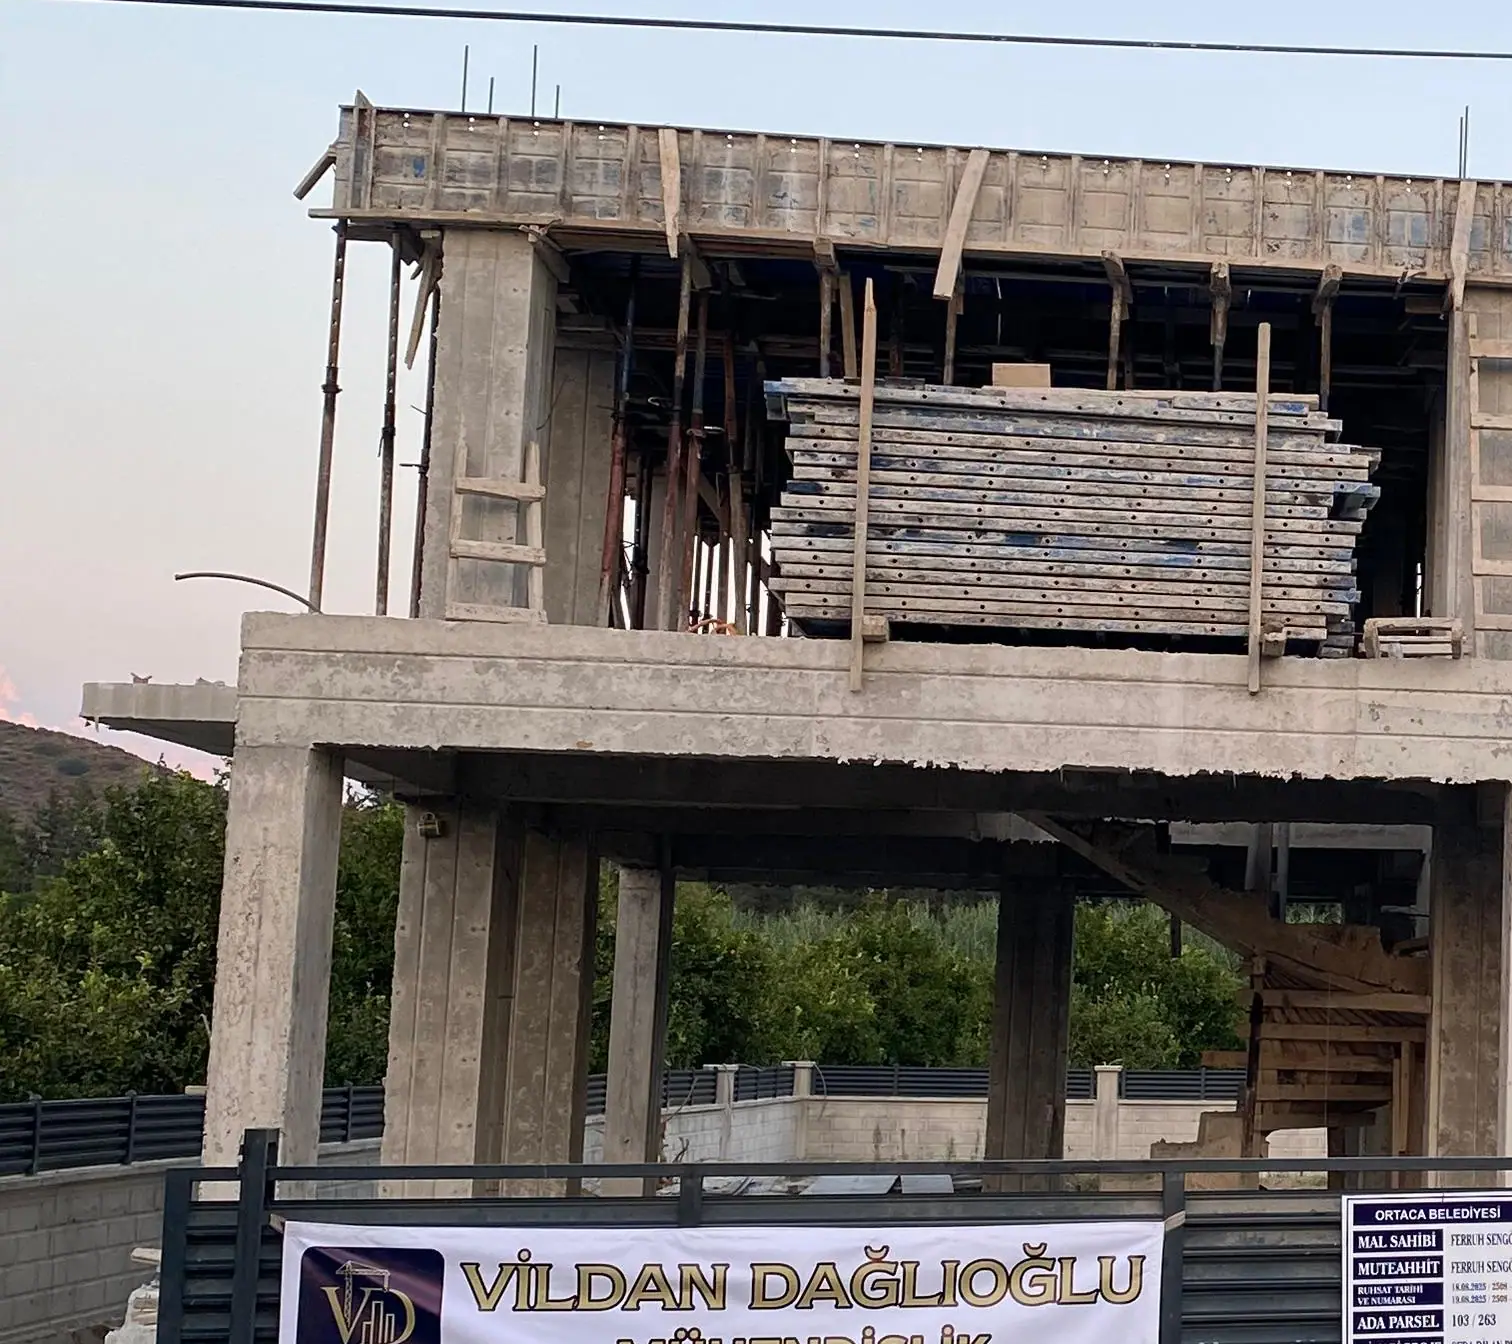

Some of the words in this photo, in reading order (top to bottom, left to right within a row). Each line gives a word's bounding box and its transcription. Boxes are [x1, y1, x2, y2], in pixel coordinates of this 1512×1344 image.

[1375, 1209, 1426, 1221] ORTACA
[1429, 1206, 1501, 1220] BELEDİYESİ
[1358, 1235, 1387, 1249] MAL
[1390, 1231, 1436, 1248] SAHİBİ
[1451, 1233, 1484, 1246] FERRUH
[1358, 1258, 1440, 1275] MUTEAHHİT
[1451, 1261, 1484, 1274] FERRUH
[461, 1249, 730, 1311] VİLDAN
[748, 1243, 1146, 1310] DAĞLIOĞLU
[1358, 1286, 1392, 1295] RUHSAT
[1357, 1297, 1369, 1306] VE
[1371, 1295, 1416, 1305] NUMARASI
[1357, 1316, 1386, 1330] ADA
[1389, 1315, 1440, 1328] PARSEL
[1452, 1314, 1469, 1327] 103
[1478, 1313, 1496, 1326] 263
